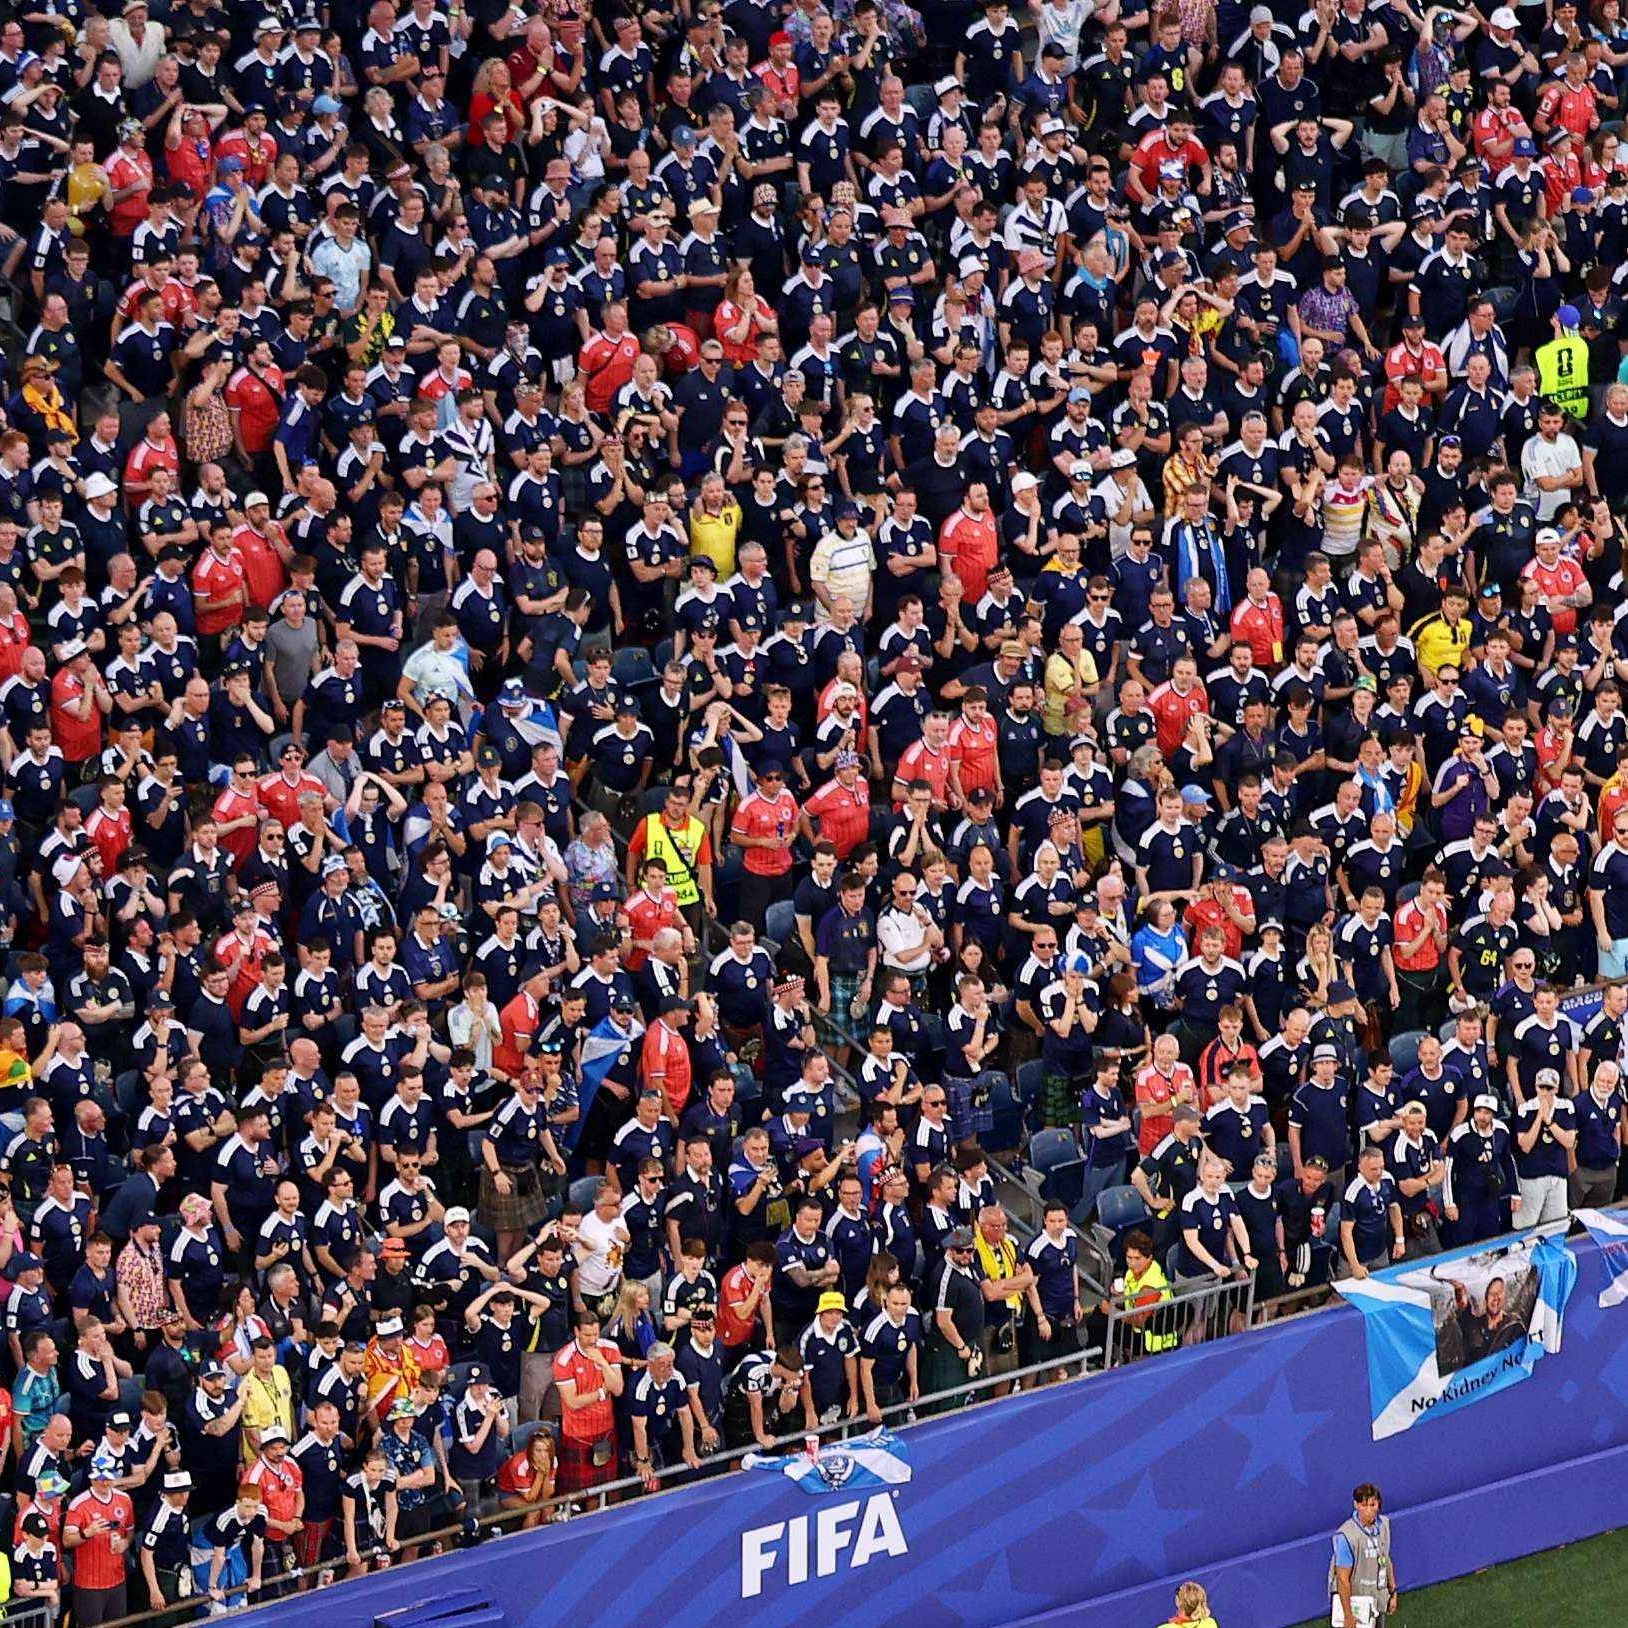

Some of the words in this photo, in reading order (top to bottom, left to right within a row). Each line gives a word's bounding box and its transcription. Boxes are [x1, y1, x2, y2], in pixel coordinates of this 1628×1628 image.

[1411, 1396, 1438, 1413] No
[1443, 1367, 1498, 1403] Kidney
[741, 1492, 908, 1598] FIFA
